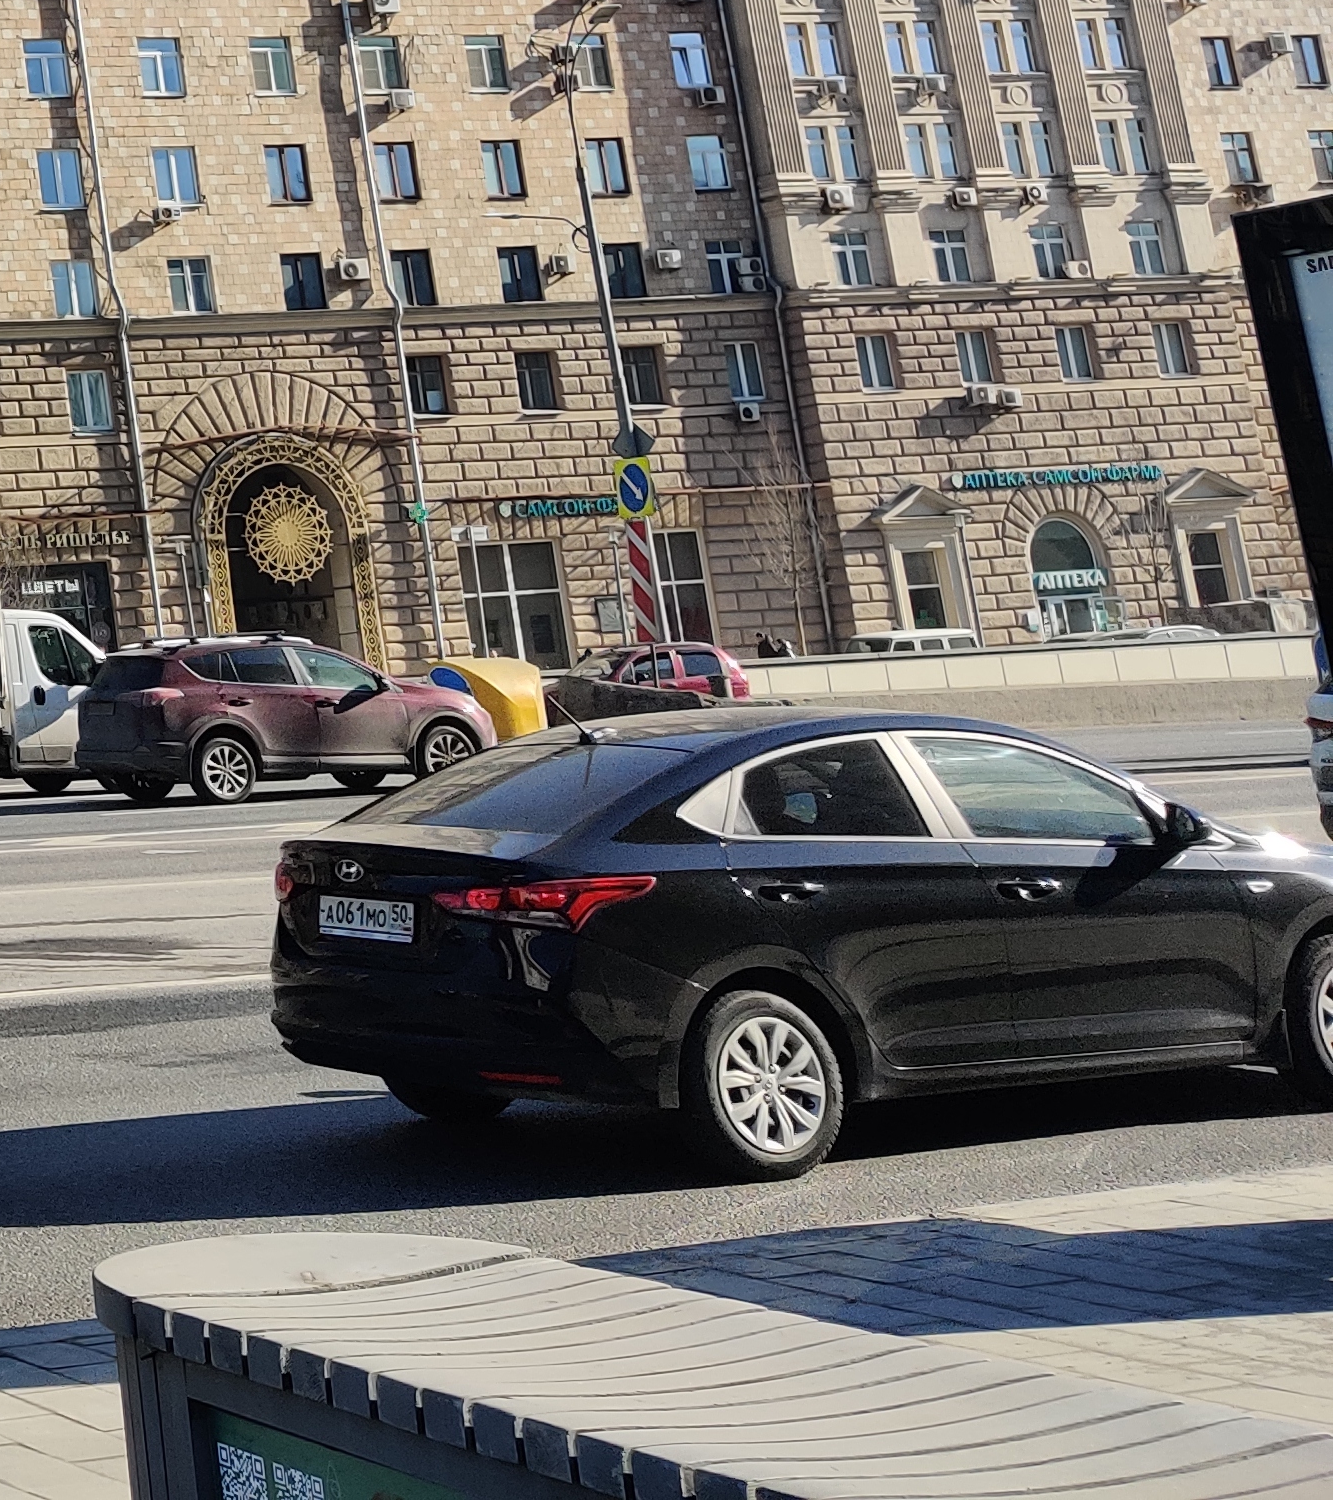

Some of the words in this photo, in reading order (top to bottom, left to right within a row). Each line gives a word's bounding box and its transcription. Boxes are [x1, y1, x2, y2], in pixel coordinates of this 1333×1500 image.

[965, 470, 1027, 489] АПТЕКА
[1033, 464, 1164, 486] САМСОН-ФАРМА
[514, 496, 619, 518] САМСОН-Ф
[46, 530, 133, 549] РИШЕЛЬЕ
[21, 578, 80, 595] ЦВЕТЫ
[1037, 569, 1107, 591] АПТЕКА
